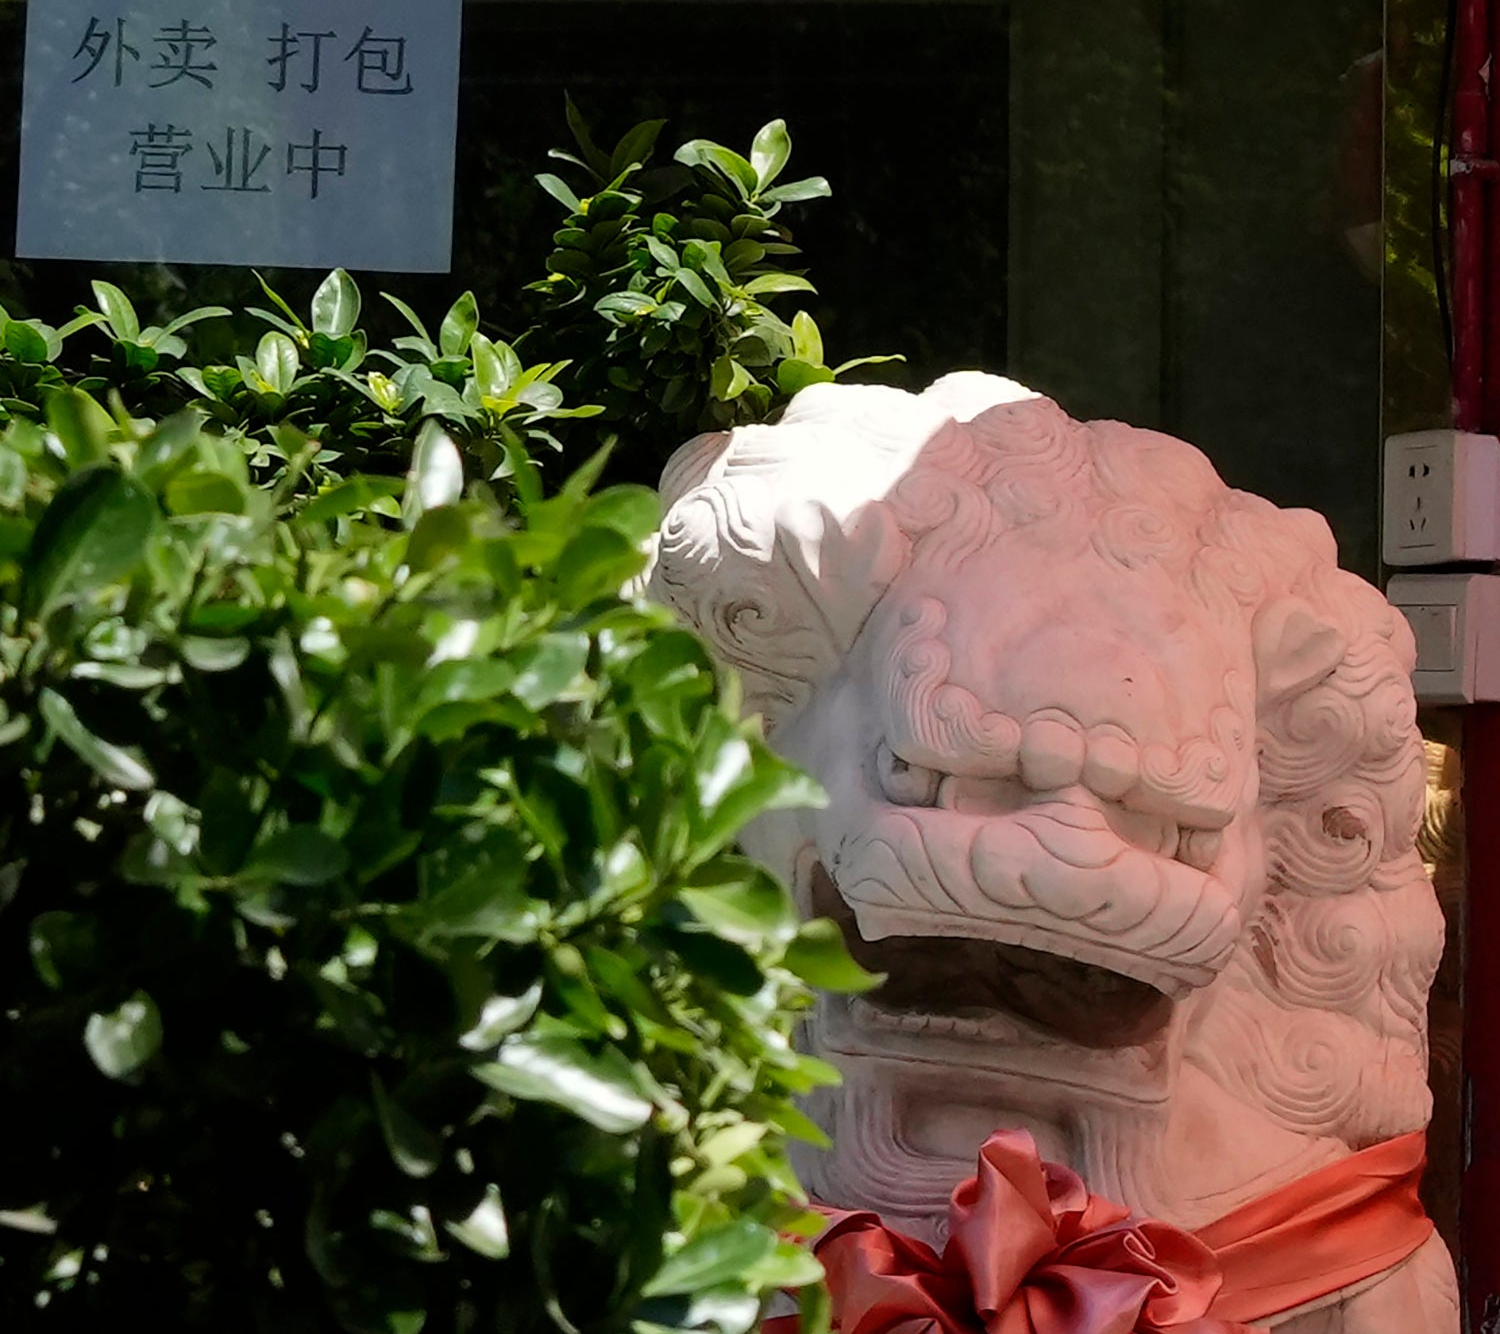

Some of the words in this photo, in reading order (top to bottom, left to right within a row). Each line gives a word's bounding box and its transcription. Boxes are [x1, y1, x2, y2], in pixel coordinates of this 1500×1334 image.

[71, 17, 219, 90] 外卖
[267, 22, 414, 95] 打包
[129, 123, 348, 199] 营业中
